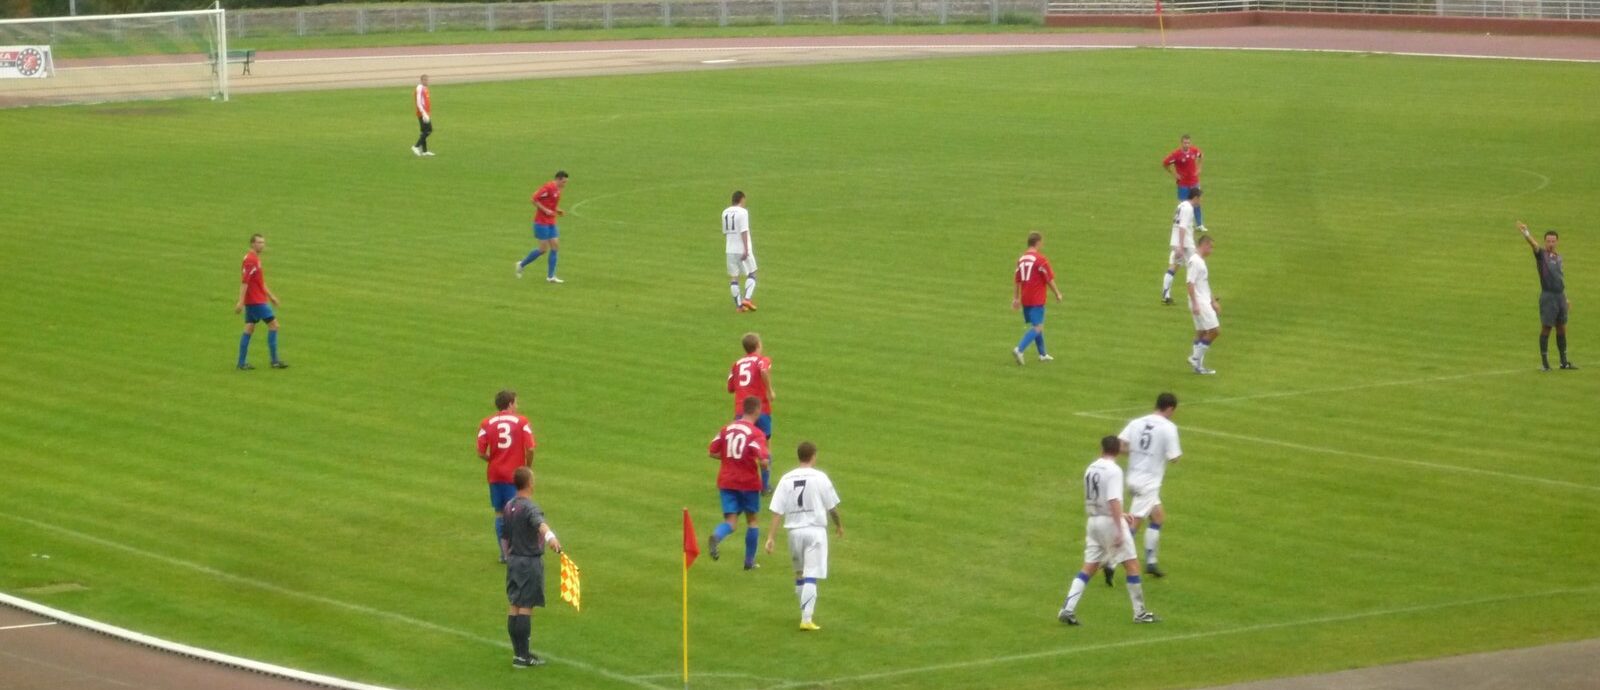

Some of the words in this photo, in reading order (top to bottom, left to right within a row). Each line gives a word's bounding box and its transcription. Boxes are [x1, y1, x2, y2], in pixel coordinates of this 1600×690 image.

[725, 213, 736, 231] 11
[1019, 261, 1034, 281] 17
[739, 361, 752, 387] 5
[497, 422, 512, 449] 3
[725, 432, 747, 460] 10
[1140, 424, 1155, 451] 5
[793, 480, 807, 508] 7
[1086, 471, 1101, 501] 18
